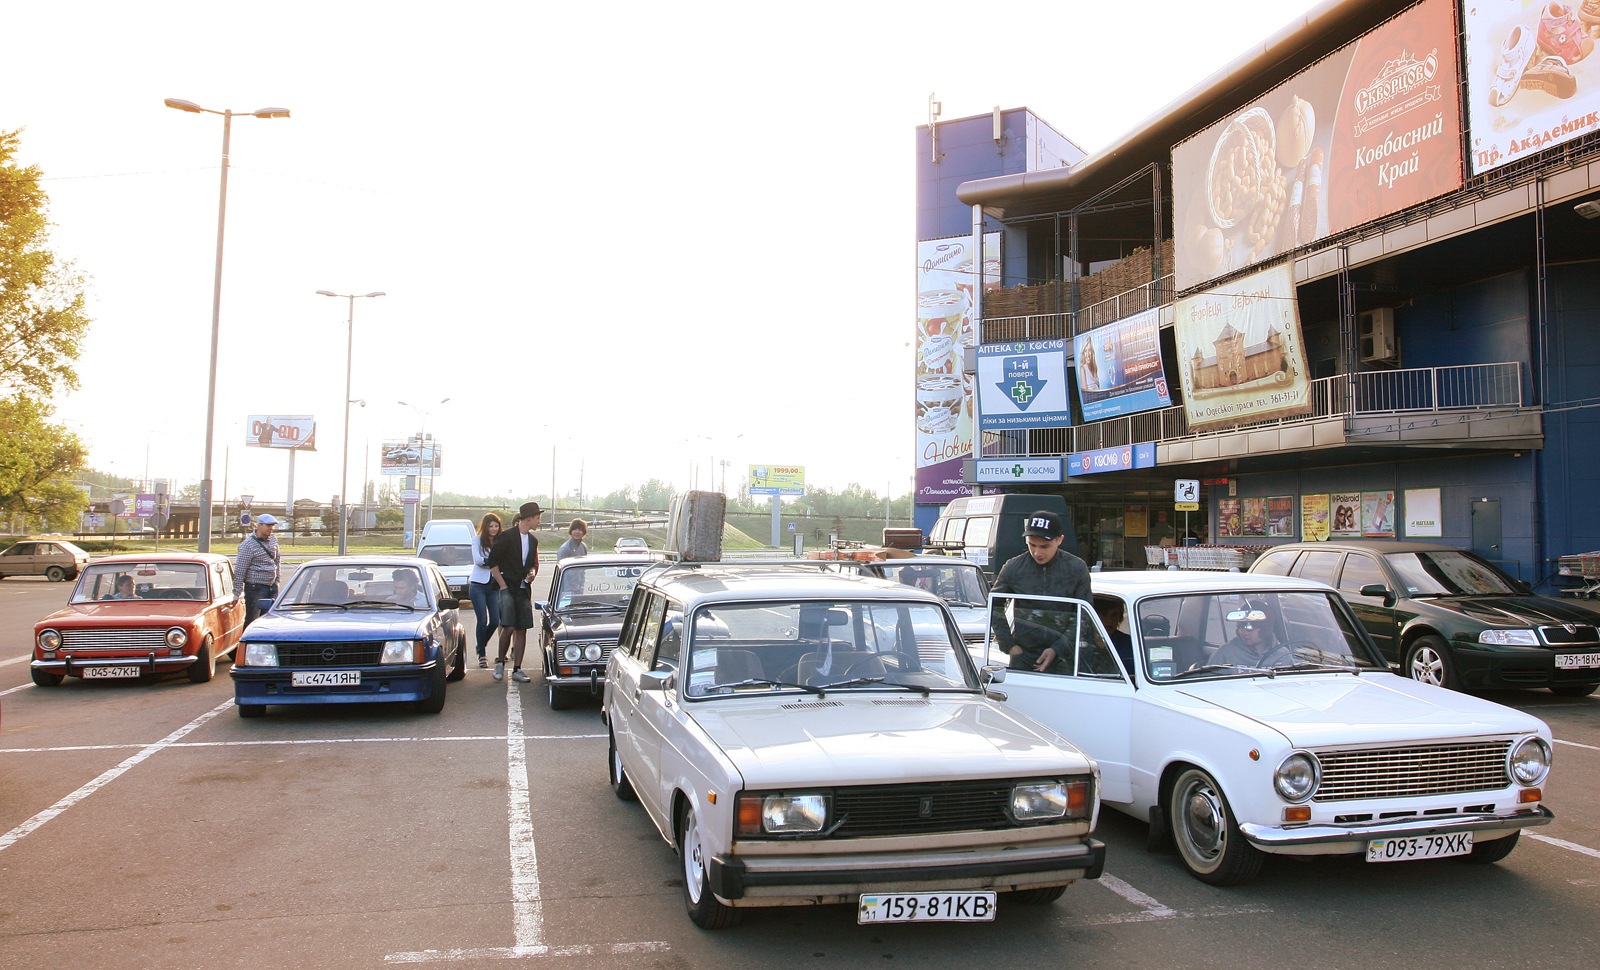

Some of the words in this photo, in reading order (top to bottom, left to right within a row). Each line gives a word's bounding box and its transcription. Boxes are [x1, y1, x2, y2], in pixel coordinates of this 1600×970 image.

[1354, 112, 1443, 170] Ковбасний
[1477, 149, 1504, 168] Пр.
[1508, 111, 1600, 156] Академик
[1378, 150, 1419, 189] Край
[978, 344, 1012, 354] АПТЕКА
[1029, 340, 1064, 351] КОСМО
[1008, 371, 1034, 379] поверх
[1270, 390, 1299, 404] 361-31-11
[999, 416, 1006, 424] за
[1007, 415, 1041, 424] низькими
[1042, 414, 1067, 423] цінами
[1094, 453, 1118, 468] КОСМО
[979, 467, 1010, 475] АПТЕКА
[1027, 466, 1056, 475] КОСМО
[1336, 495, 1360, 503] Polaroid
[1031, 517, 1050, 530] FBI
[1385, 833, 1468, 858] 093-79ХК
[865, 911, 876, 919] 11
[881, 896, 988, 919] 159-81КВ
